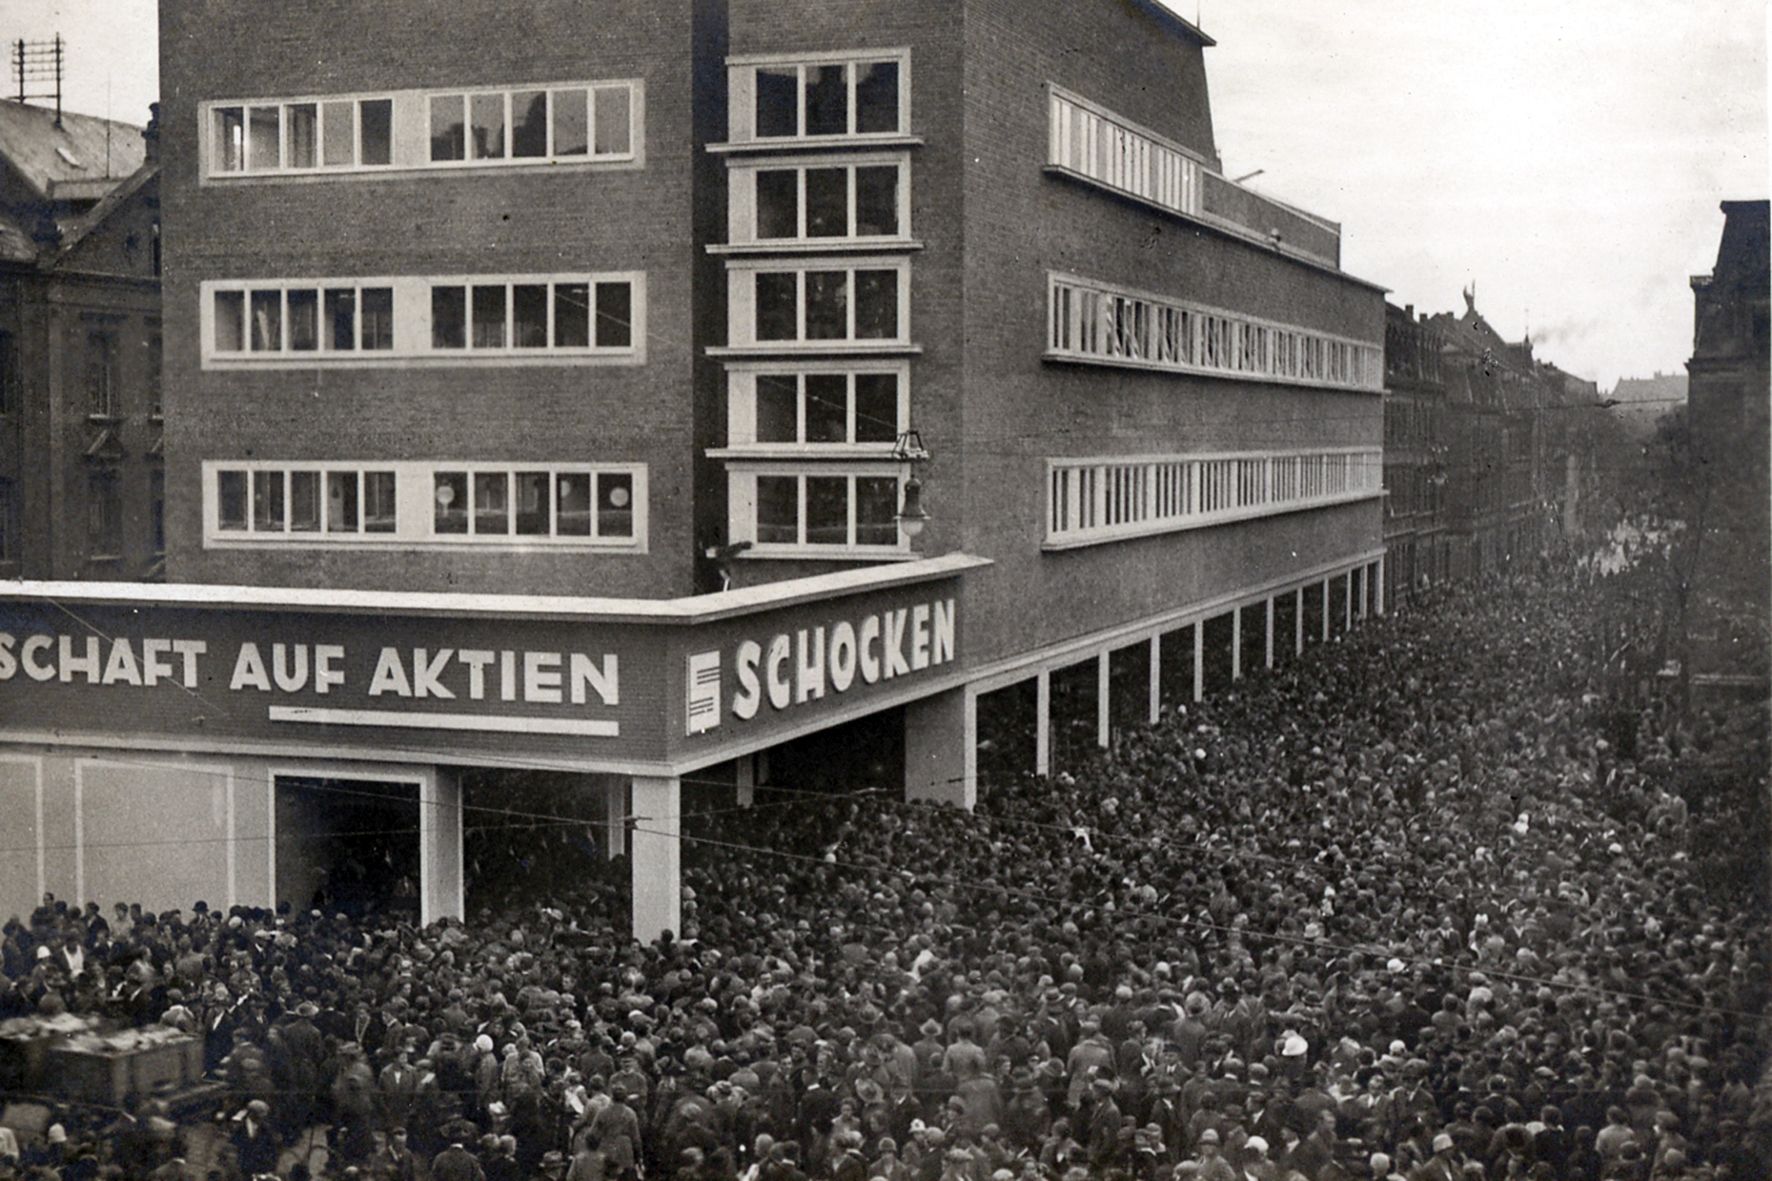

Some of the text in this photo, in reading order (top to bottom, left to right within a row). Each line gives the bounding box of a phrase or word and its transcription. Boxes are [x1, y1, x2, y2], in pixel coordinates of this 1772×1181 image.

[0, 632, 619, 705] SCHAFT AUF AKTIEN
[732, 599, 955, 720] SCHOCKEN
